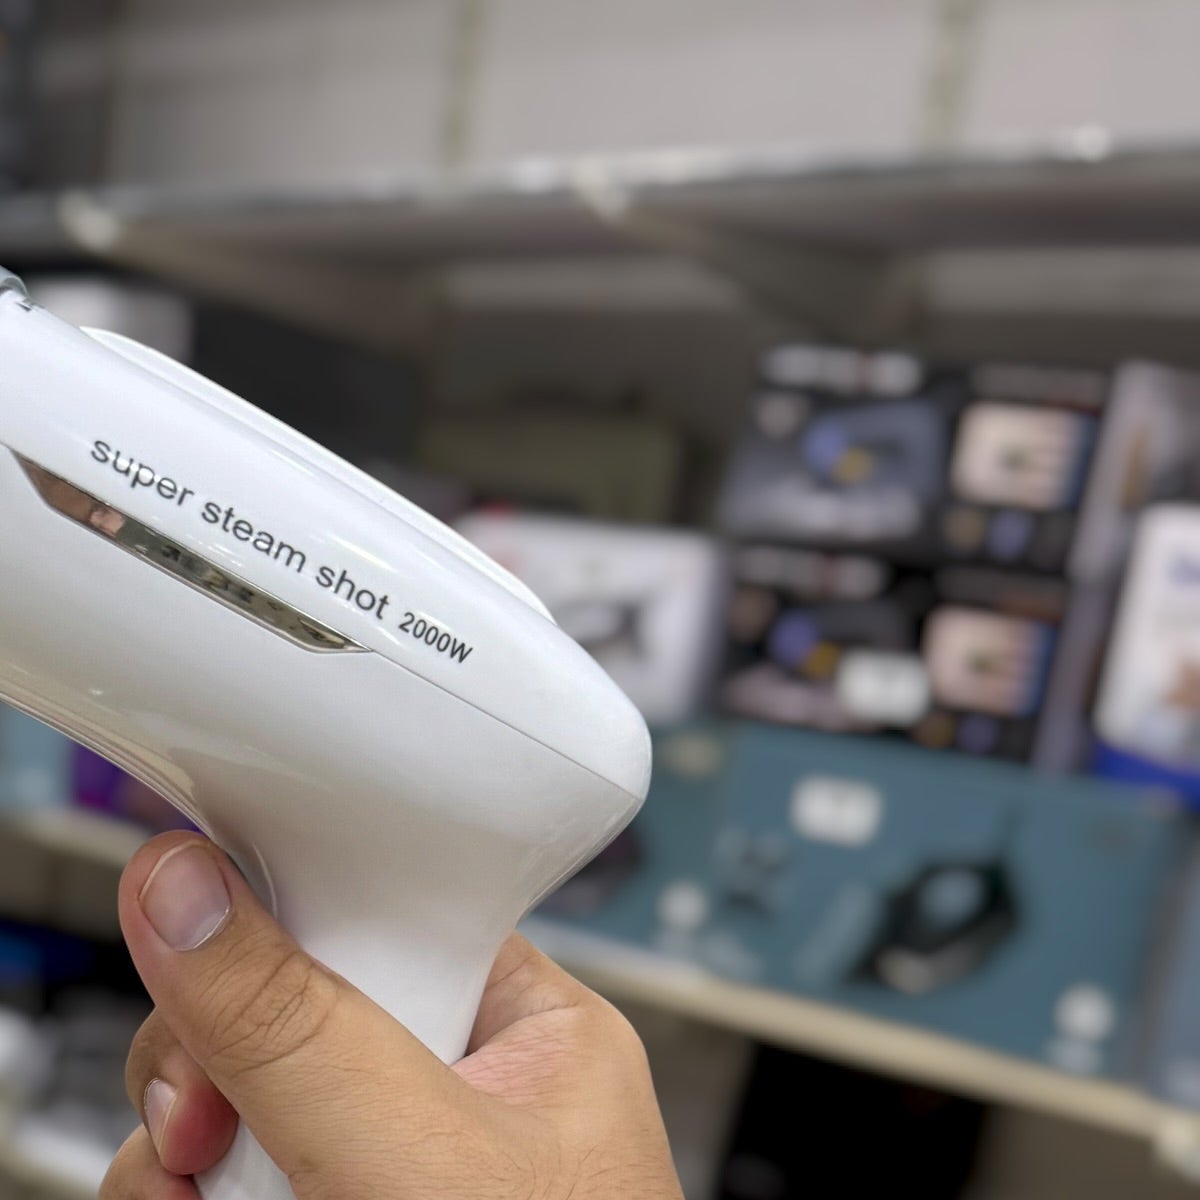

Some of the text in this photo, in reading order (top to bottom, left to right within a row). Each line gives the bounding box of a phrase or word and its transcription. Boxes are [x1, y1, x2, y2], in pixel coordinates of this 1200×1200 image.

[90, 439, 474, 664] super steam shot 2000W
